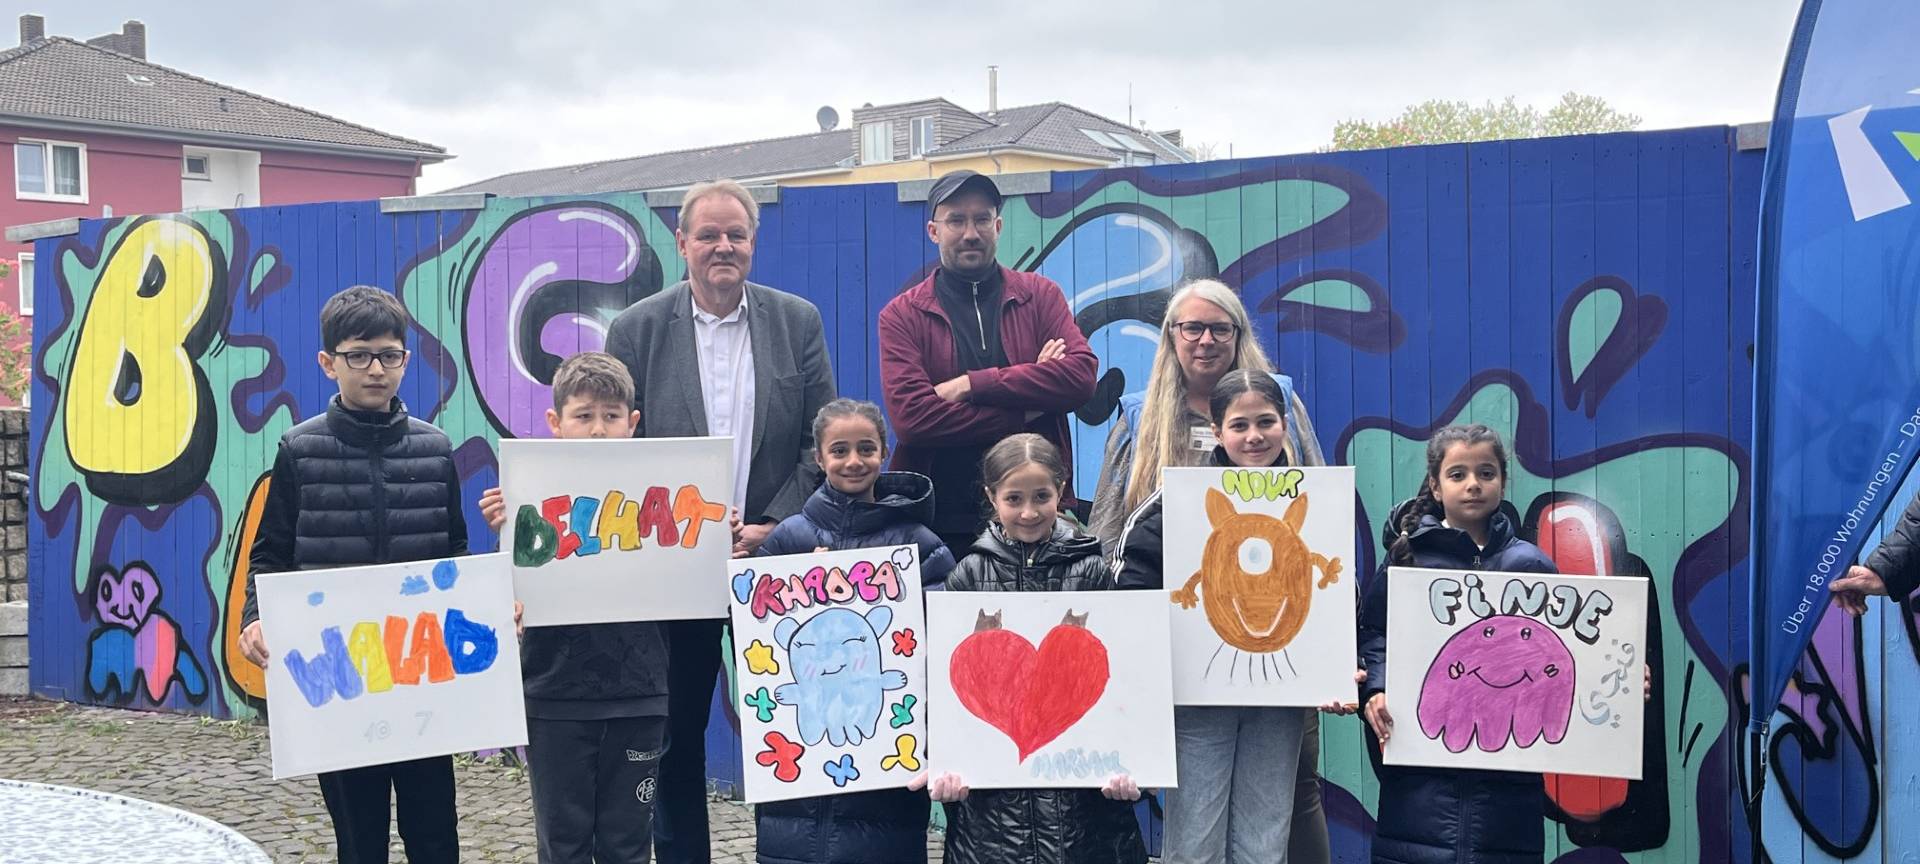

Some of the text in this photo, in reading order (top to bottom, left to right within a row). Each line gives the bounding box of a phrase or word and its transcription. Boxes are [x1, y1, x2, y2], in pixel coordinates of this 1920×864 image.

[512, 484, 727, 568] DELHAT
[1221, 468, 1305, 503] NOUR
[1782, 597, 1813, 635] Über
[1805, 543, 1842, 594] 18.000
[1832, 451, 1901, 544] Wohnungen
[751, 560, 906, 623] KHADRA
[283, 607, 499, 708] WALAD
